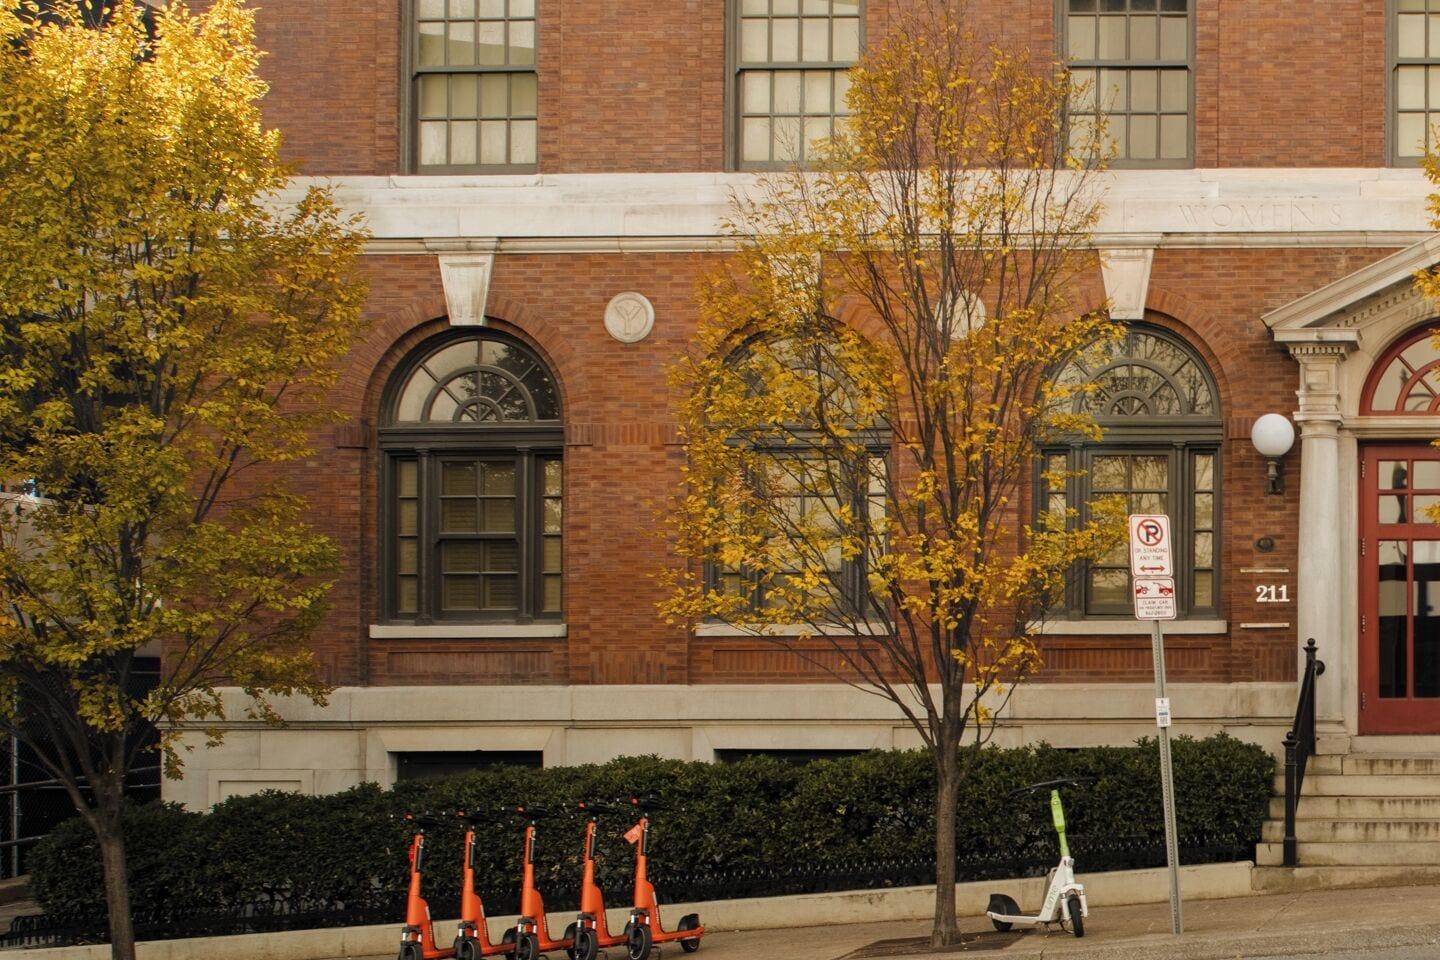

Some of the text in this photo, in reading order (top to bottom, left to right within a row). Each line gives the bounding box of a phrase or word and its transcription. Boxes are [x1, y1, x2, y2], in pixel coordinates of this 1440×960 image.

[613, 305, 643, 336] Y
[1145, 525, 1159, 542] P
[1256, 585, 1290, 602] 211
